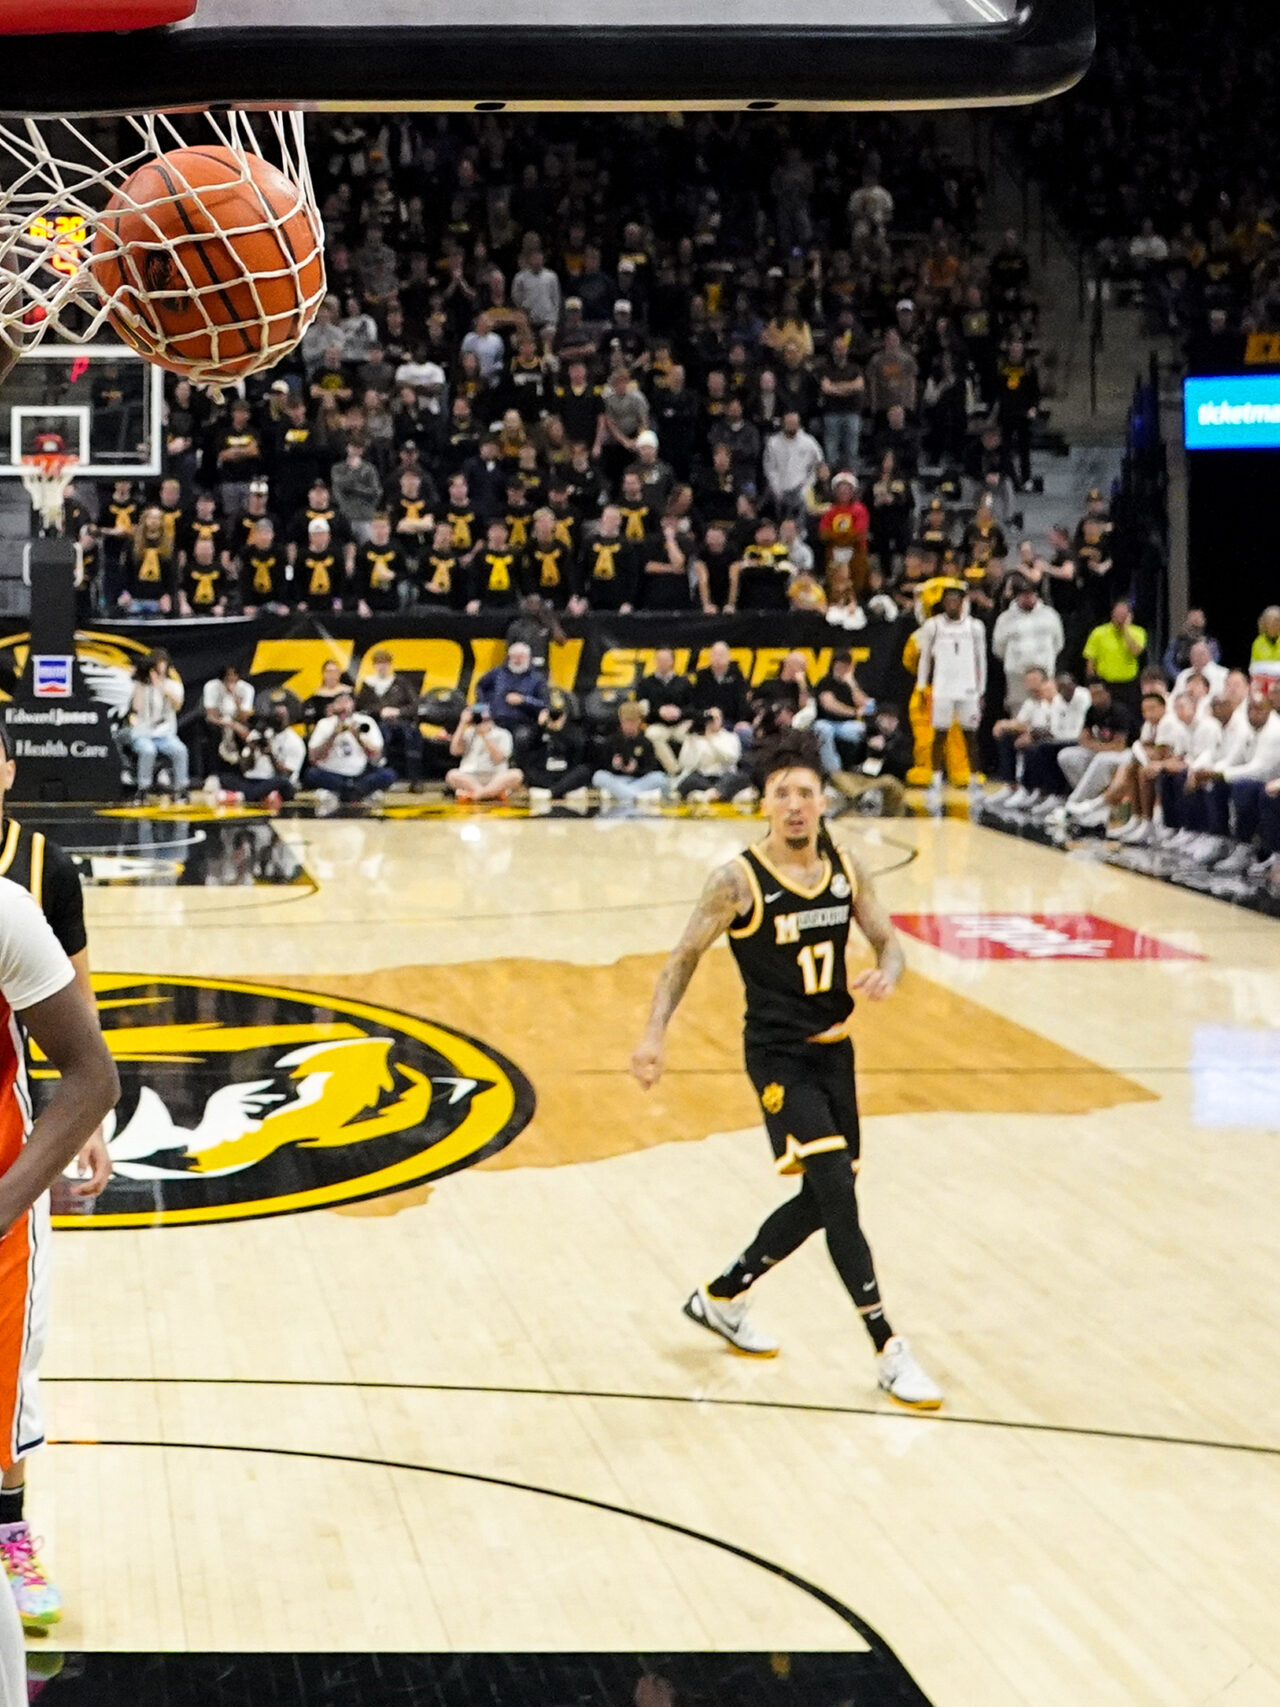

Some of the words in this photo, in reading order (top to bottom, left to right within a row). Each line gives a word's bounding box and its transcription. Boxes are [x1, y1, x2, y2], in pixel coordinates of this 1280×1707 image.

[15, 739, 68, 757] Health
[70, 740, 109, 758] Care
[797, 940, 834, 996] 17
